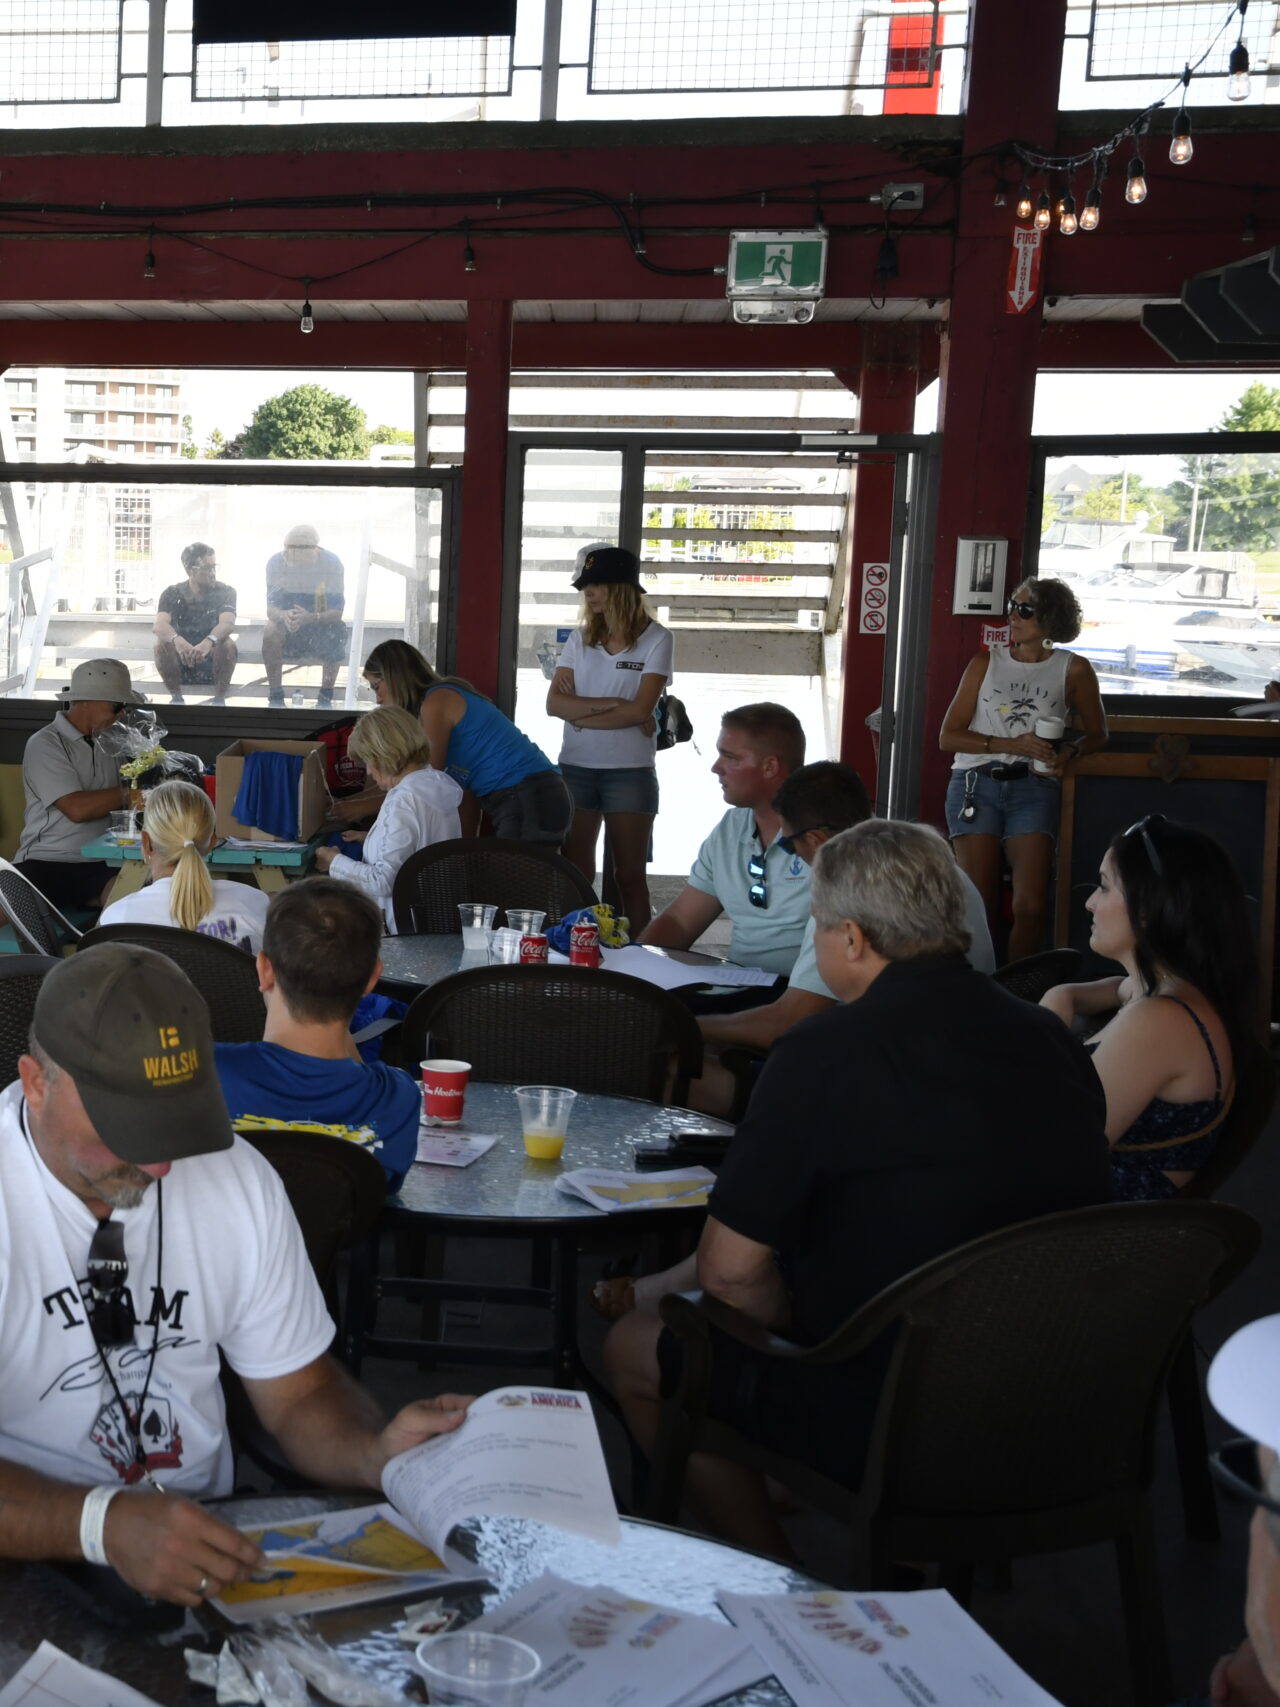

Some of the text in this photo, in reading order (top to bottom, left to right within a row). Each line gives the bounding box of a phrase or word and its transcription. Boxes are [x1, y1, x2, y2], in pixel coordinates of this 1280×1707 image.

[1016, 232, 1038, 245] FIRE
[986, 630, 1007, 642] FIRE
[143, 1048, 199, 1079] WALSH
